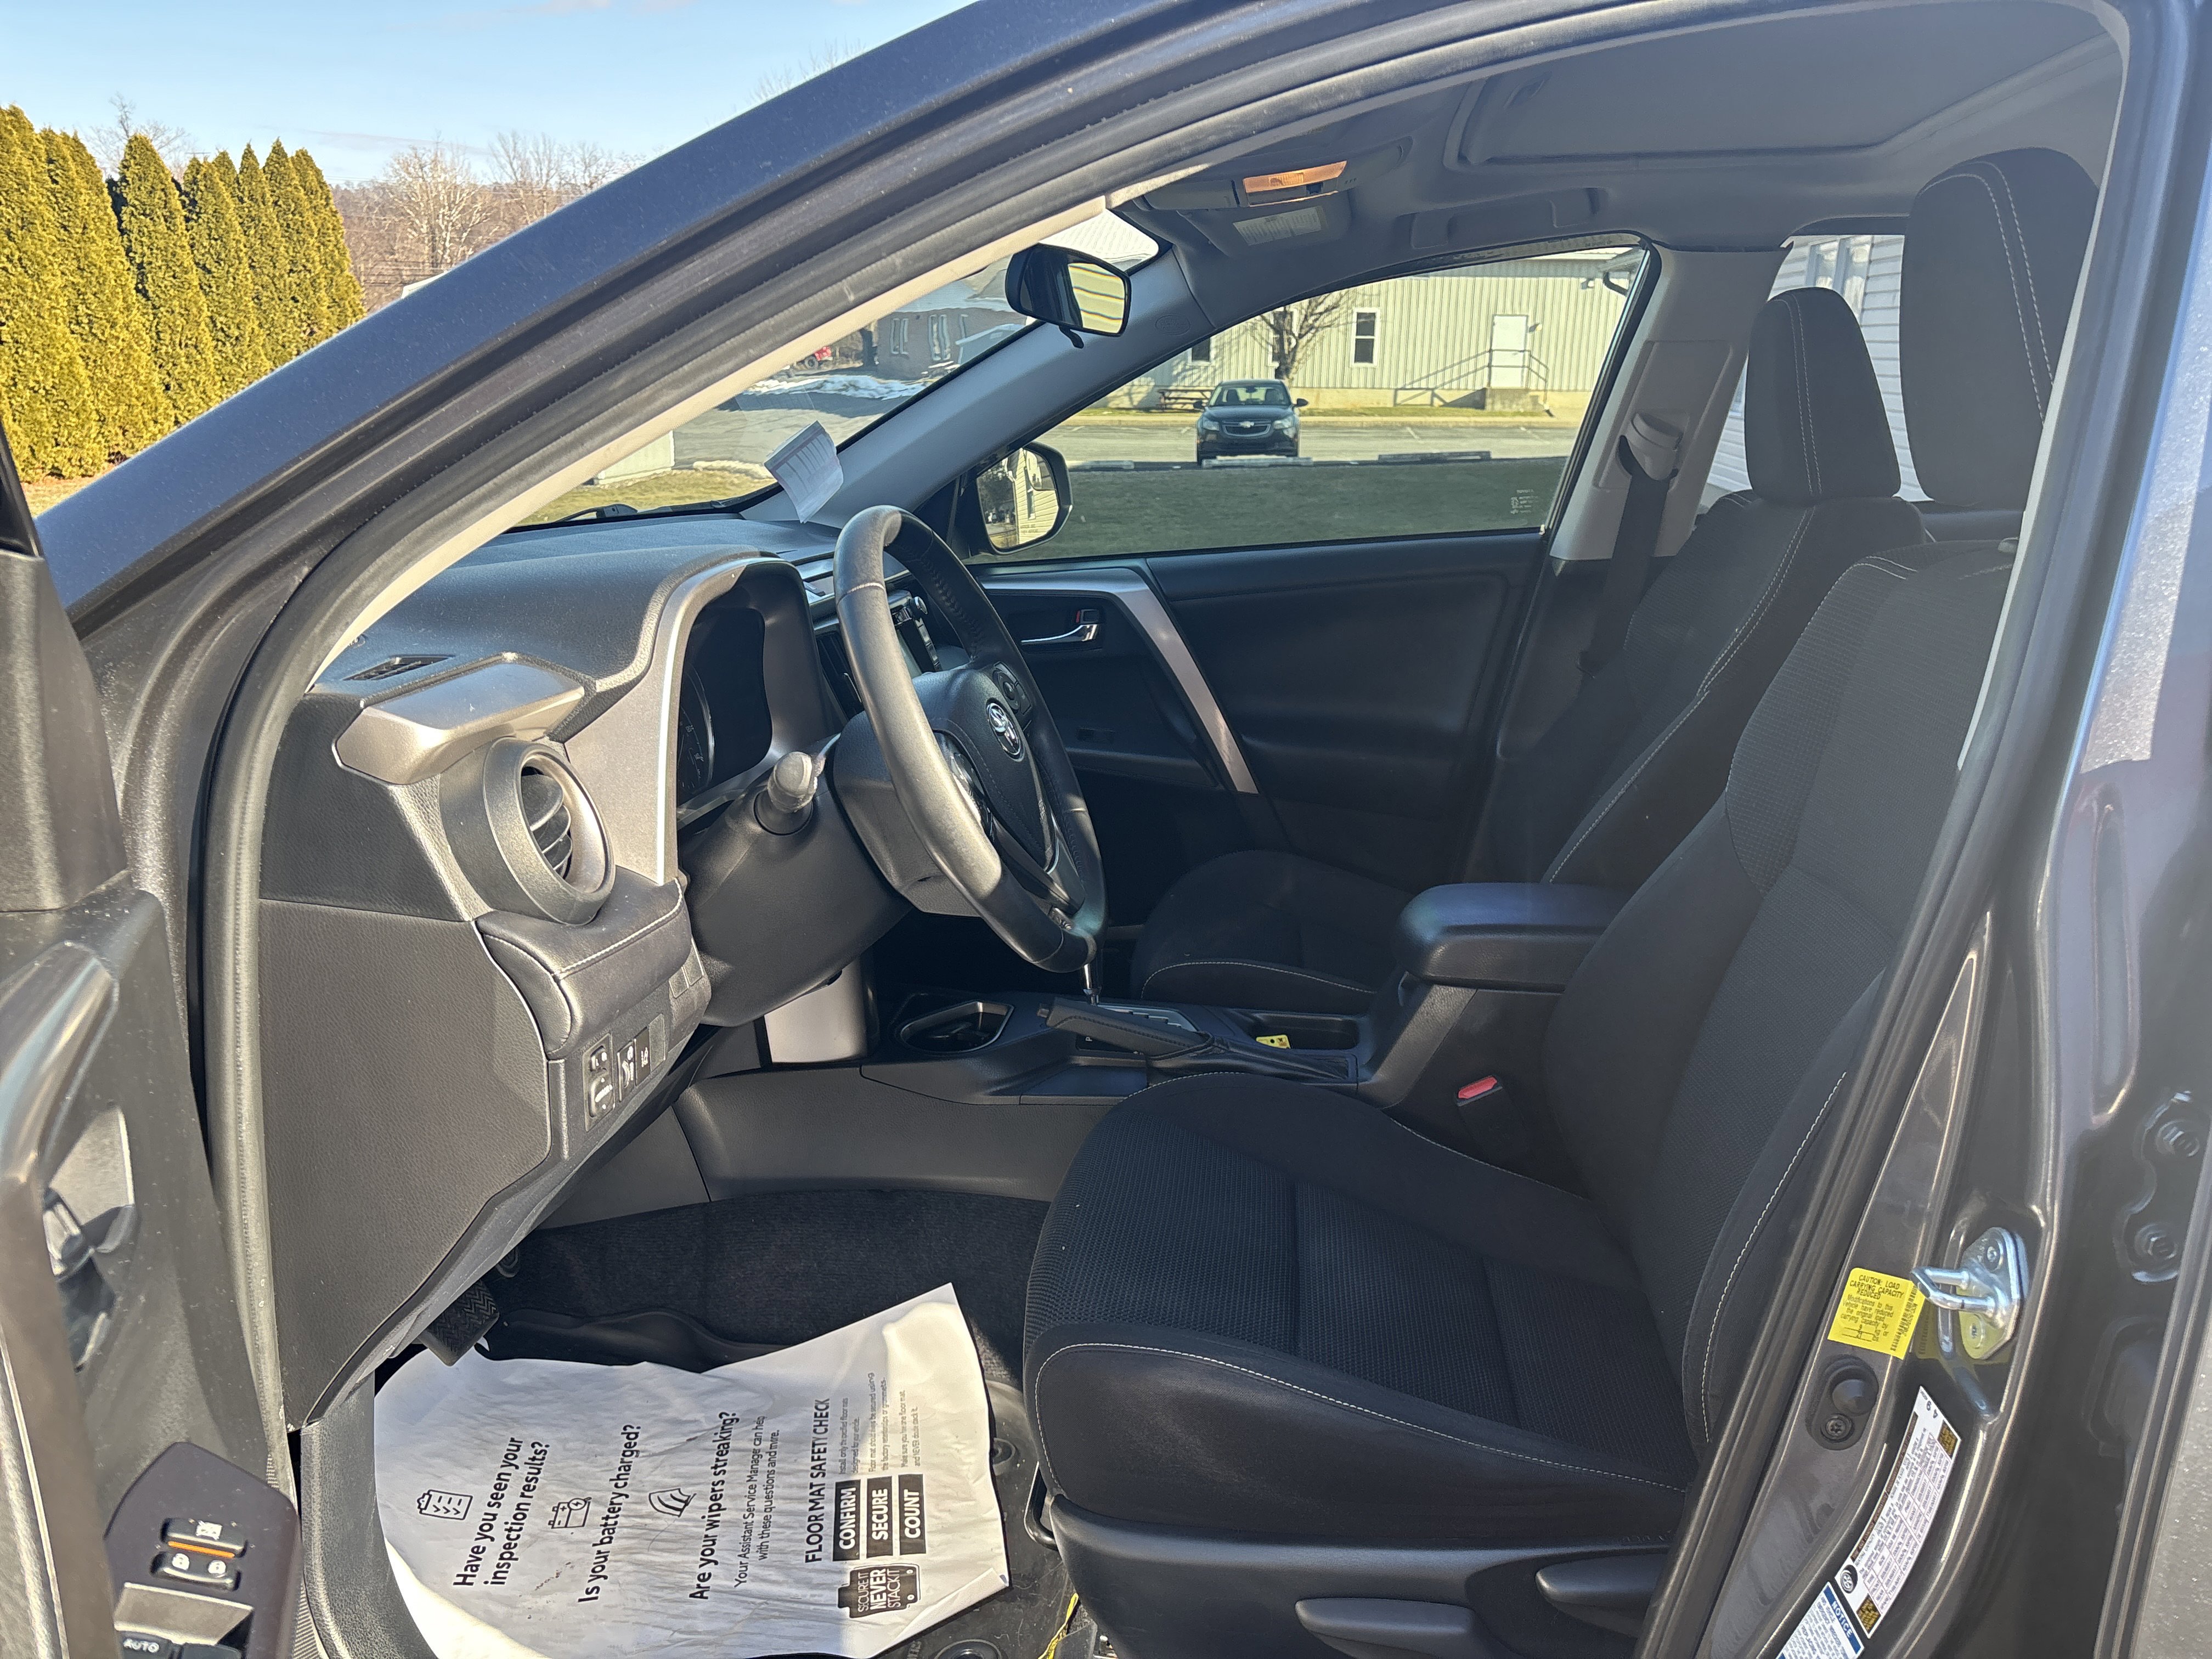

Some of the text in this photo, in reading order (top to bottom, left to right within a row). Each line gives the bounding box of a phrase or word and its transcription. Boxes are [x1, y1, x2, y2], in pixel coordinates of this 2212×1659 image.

[1849, 1280, 1904, 1298] CARRYING CAPACITY
[1857, 1289, 1881, 1300] REDUCED
[1885, 1280, 1900, 1289] LOAD
[754, 1432, 763, 1446] can
[765, 1451, 777, 1468] and
[763, 1469, 776, 1513] questions
[805, 1398, 830, 1563] FLOOR MAT SAFETY CHECK
[453, 1437, 523, 1585] Have you seen your
[483, 1441, 550, 1584] inspection results?
[578, 1425, 641, 1602] Is your battery charged?
[689, 1412, 740, 1600] Are your wipers streaking?
[743, 1484, 757, 1519] Service
[839, 1487, 856, 1549] CONFIRM
[872, 1488, 888, 1540] SECURE
[904, 1489, 921, 1538] COUNT
[737, 1521, 754, 1559] Assistant
[758, 1515, 772, 1539] these
[756, 1541, 769, 1560] with
[734, 1561, 748, 1588] Your
[870, 1568, 887, 1610] NEVER
[887, 1568, 901, 1608] STACK IT
[857, 1580, 869, 1612] SECURE
[1832, 1601, 1852, 1638] NOTICE
[123, 1639, 159, 1653] AUTO
